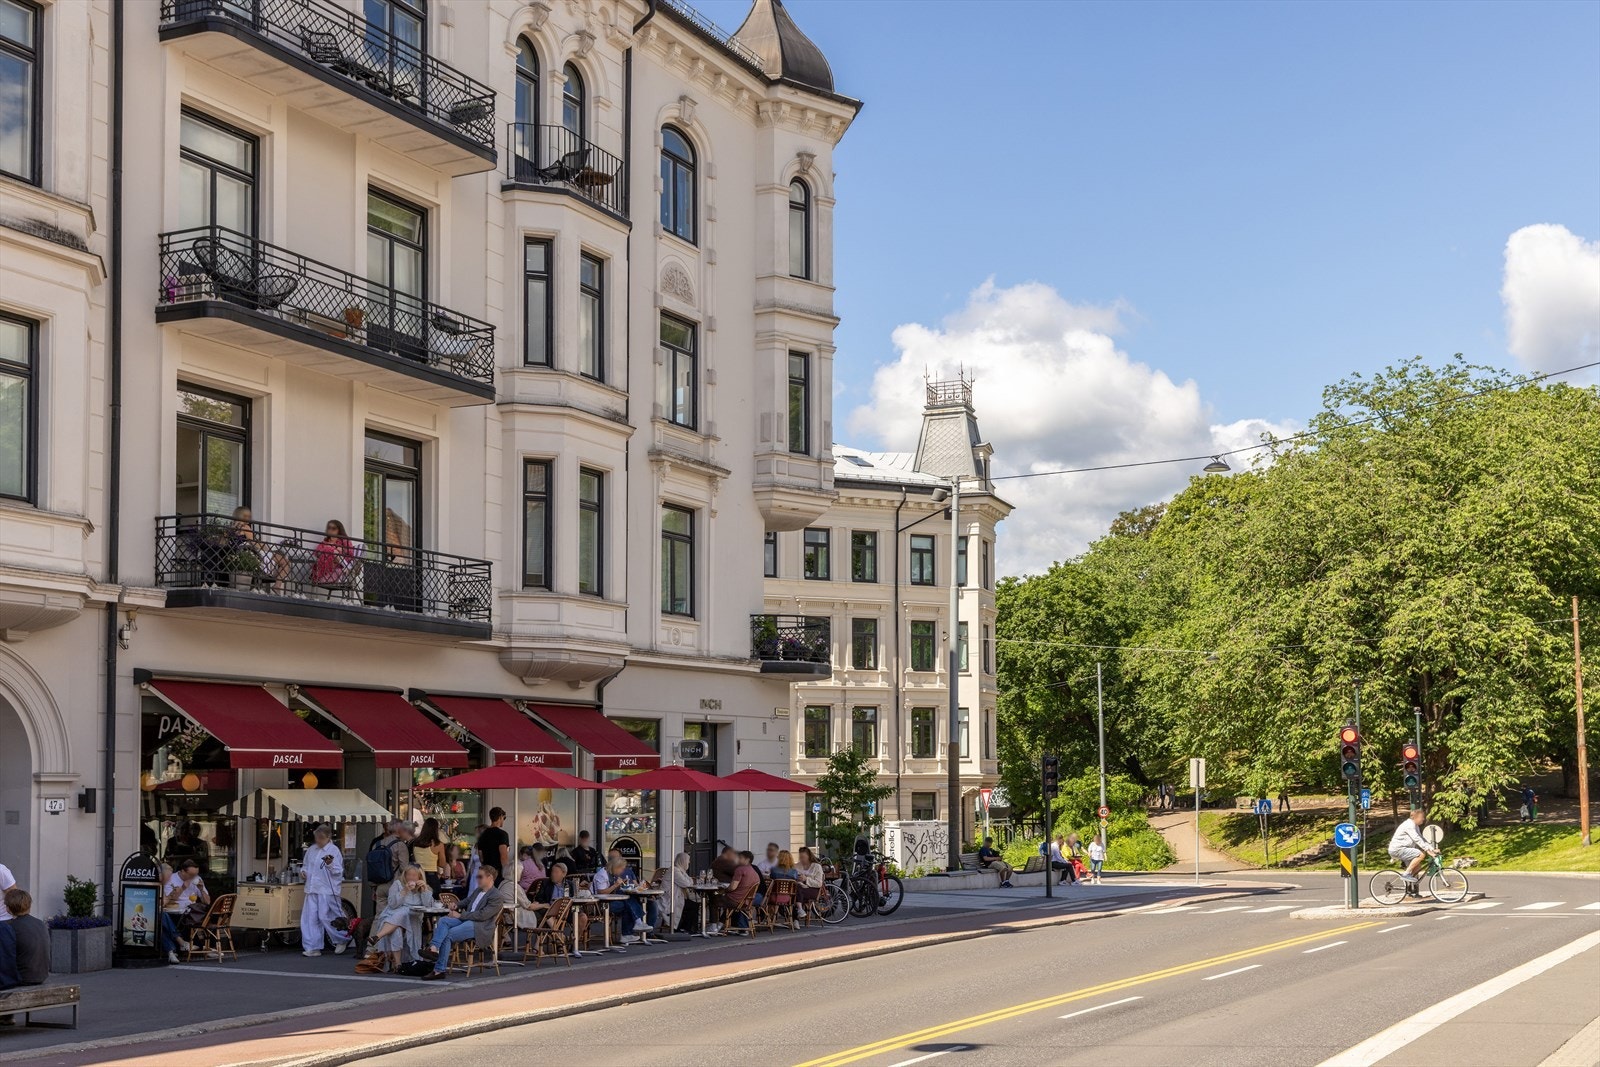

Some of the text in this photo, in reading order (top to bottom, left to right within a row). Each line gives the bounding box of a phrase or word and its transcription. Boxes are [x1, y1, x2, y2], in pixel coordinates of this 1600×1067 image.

[699, 698, 722, 711] INCH
[272, 753, 304, 767] PASCAL
[409, 753, 436, 766] PASCAL
[618, 758, 638, 768] PASCAL
[125, 867, 156, 878] PASCAL
